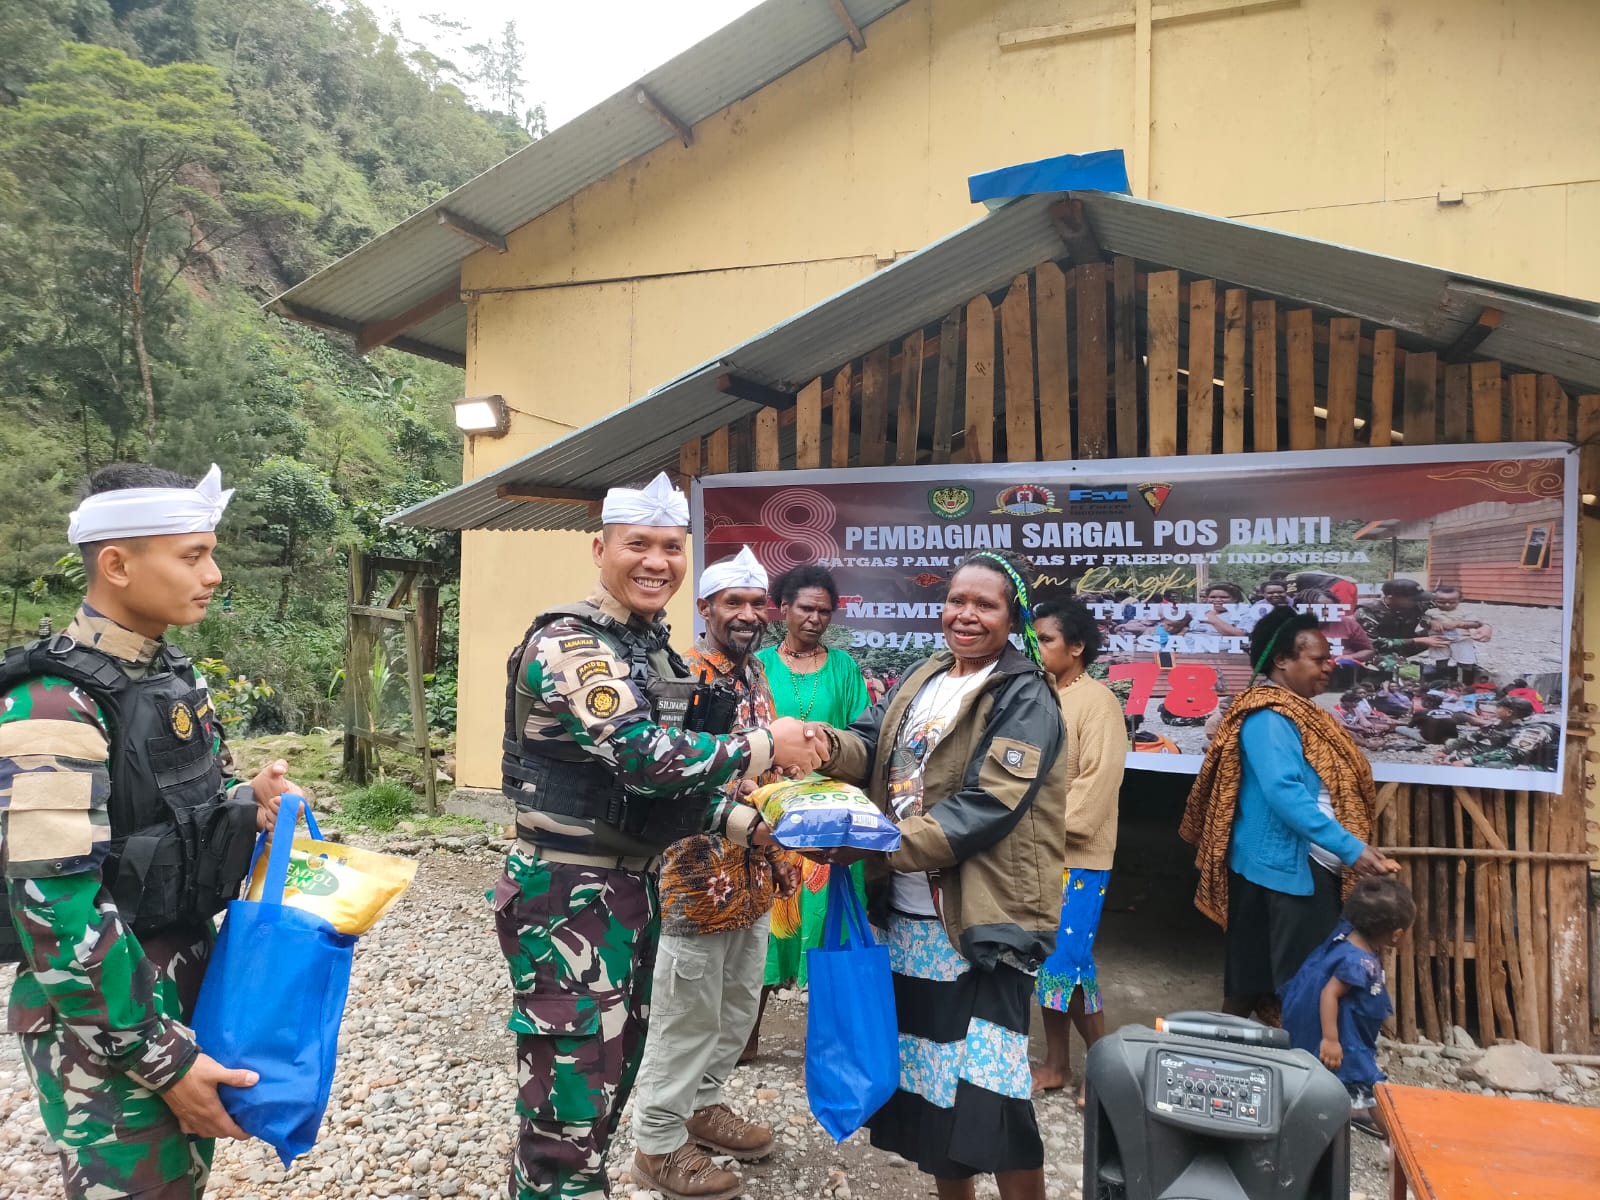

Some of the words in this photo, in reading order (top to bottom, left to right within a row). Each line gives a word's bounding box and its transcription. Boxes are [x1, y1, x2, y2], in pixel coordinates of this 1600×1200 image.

[846, 526, 1012, 550] PEMBAGIAN
[1022, 521, 1142, 548] SARGAL
[1153, 519, 1219, 547] POS
[1230, 517, 1331, 545] BANTI
[817, 557, 898, 567] SATGAS
[902, 556, 949, 567] PAM
[1070, 555, 1098, 566] PT
[1102, 552, 1221, 565] FREEPORT
[1228, 551, 1370, 563] INDONESIA
[579, 661, 606, 674] RAIDER
[1109, 662, 1219, 717] 78
